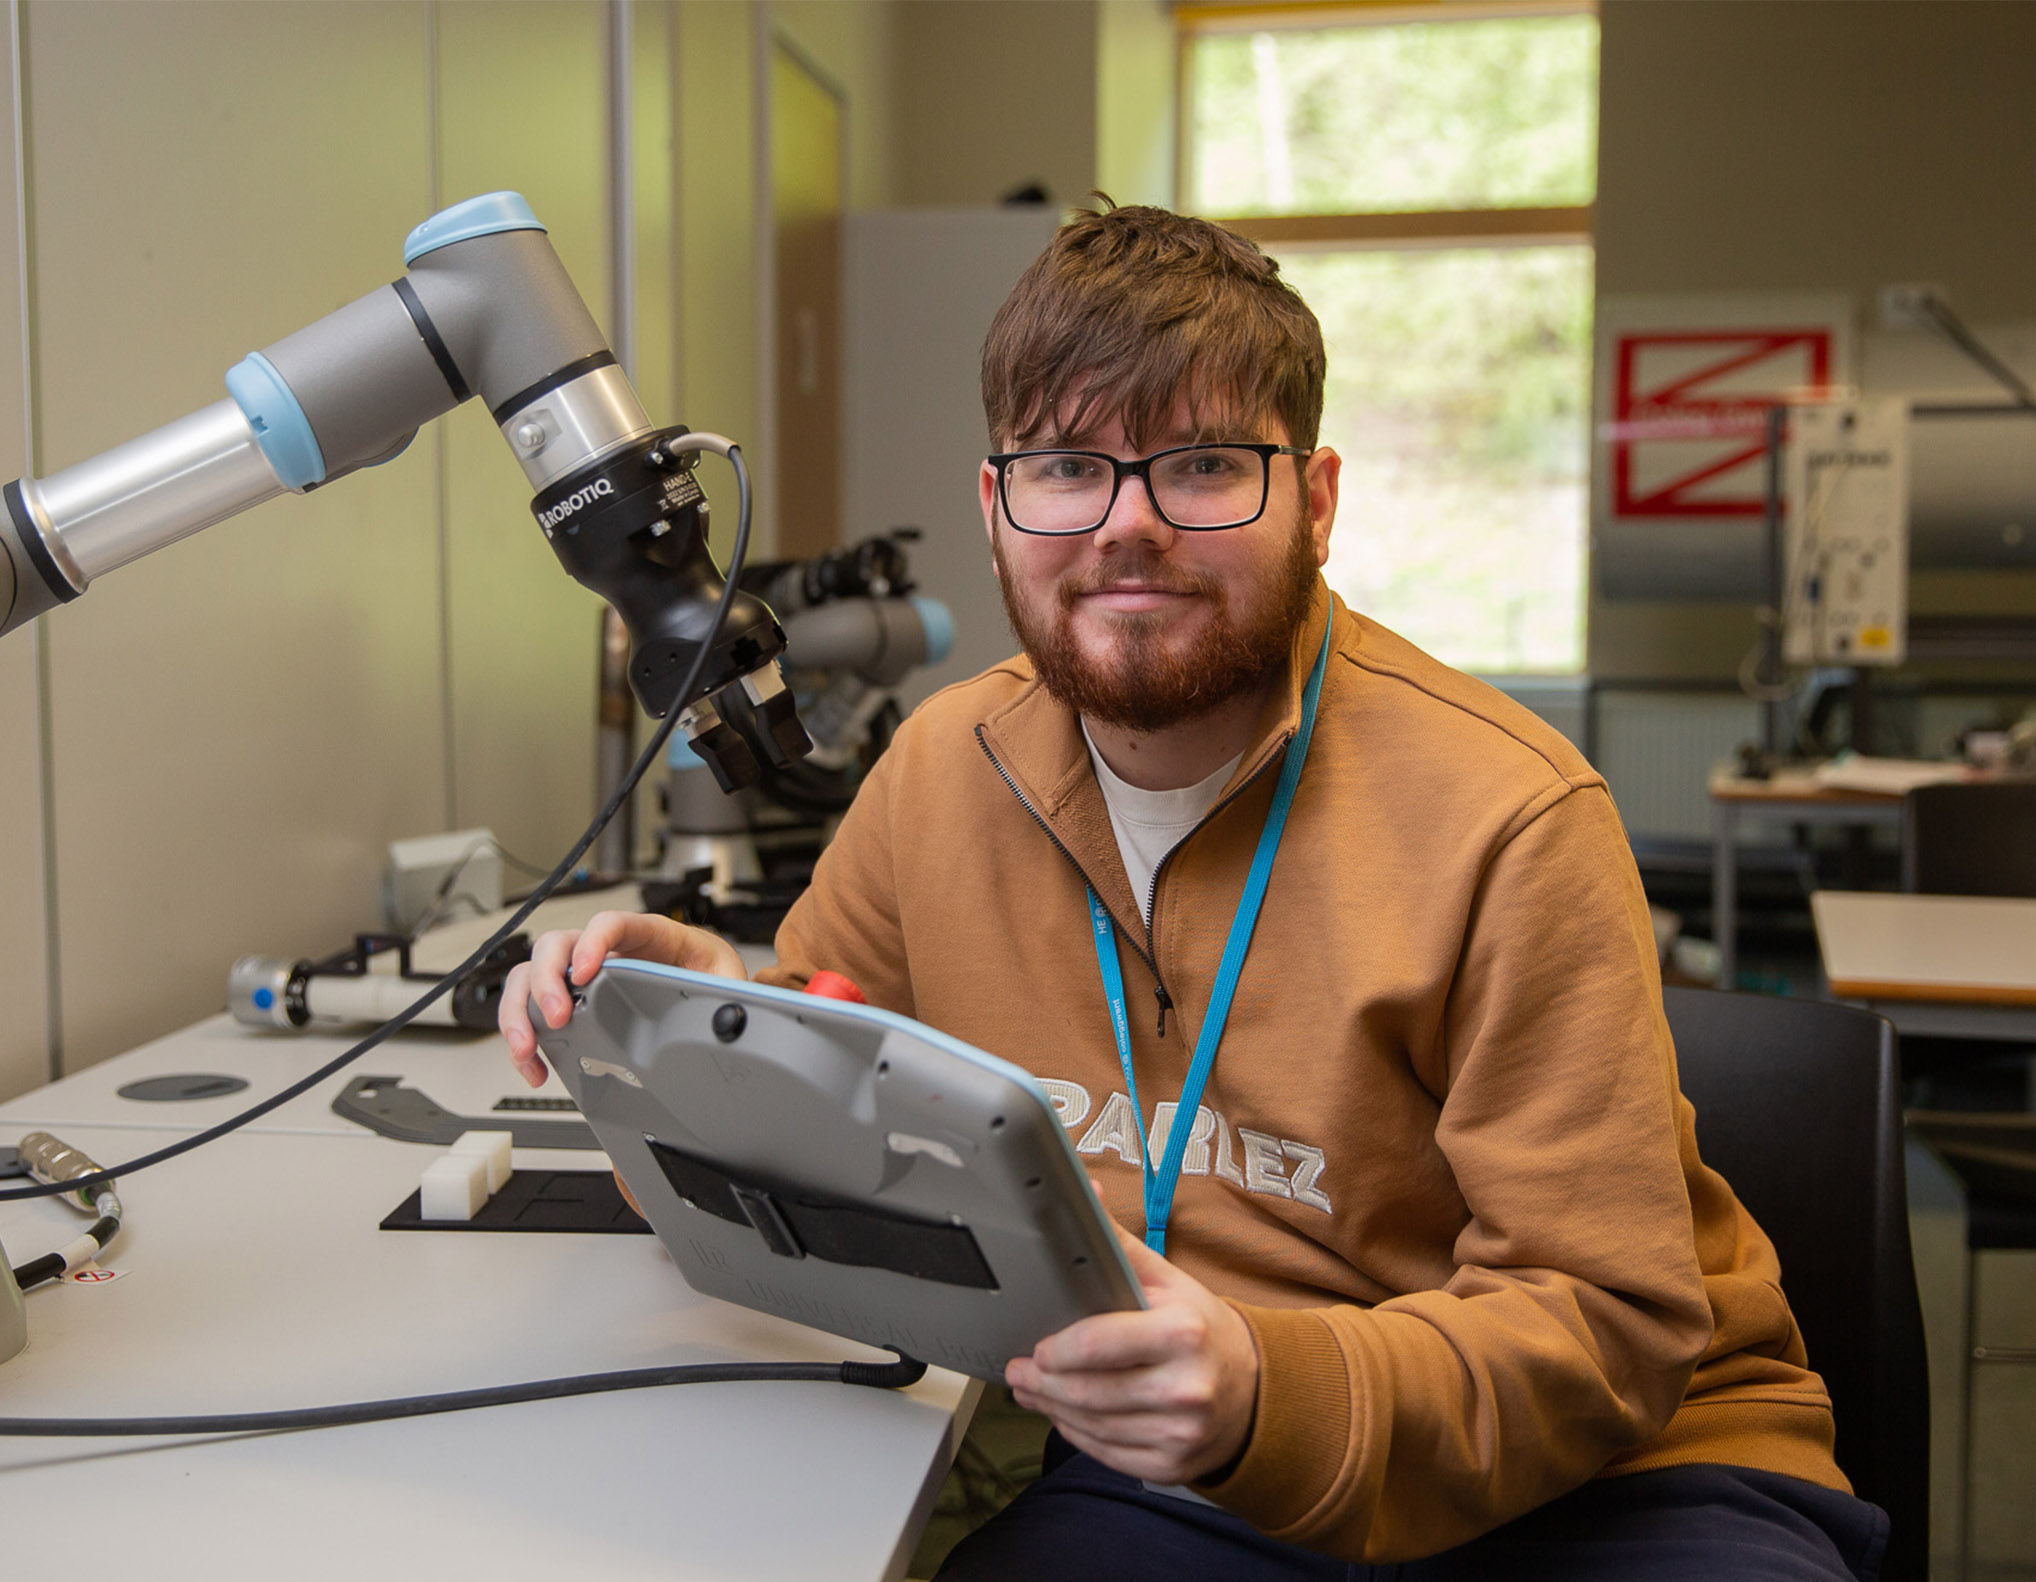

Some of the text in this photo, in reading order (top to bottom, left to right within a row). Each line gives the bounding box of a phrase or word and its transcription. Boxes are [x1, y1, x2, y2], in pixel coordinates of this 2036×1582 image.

[545, 478, 615, 527] ROBOTIQ
[1096, 919, 1107, 935] HE
[1033, 1077, 1333, 1216] PARLEZ
